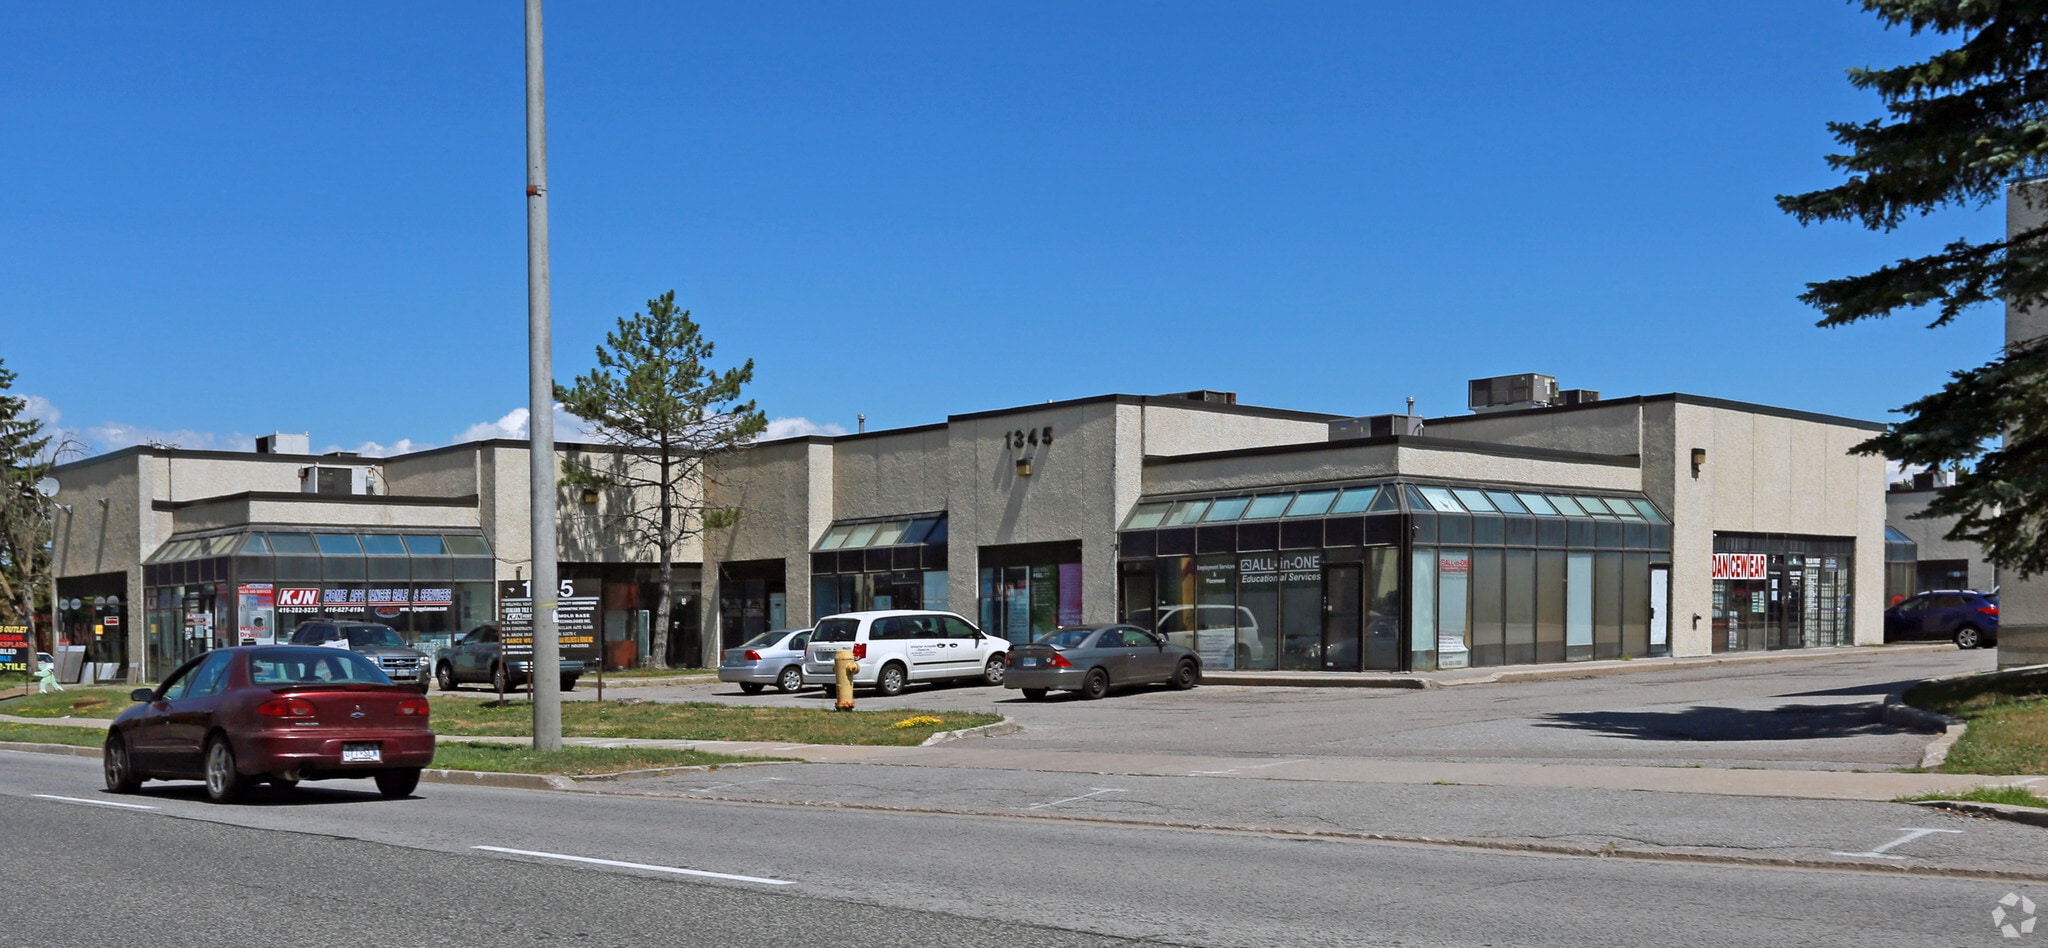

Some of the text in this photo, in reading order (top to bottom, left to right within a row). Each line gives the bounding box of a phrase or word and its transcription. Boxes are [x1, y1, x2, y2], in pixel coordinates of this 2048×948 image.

[1005, 426, 1053, 450] 1345
[1242, 572, 1321, 583] Educational Services
[280, 590, 317, 604] KJN
[324, 589, 347, 602] HOME
[420, 589, 452, 601] SERVICES
